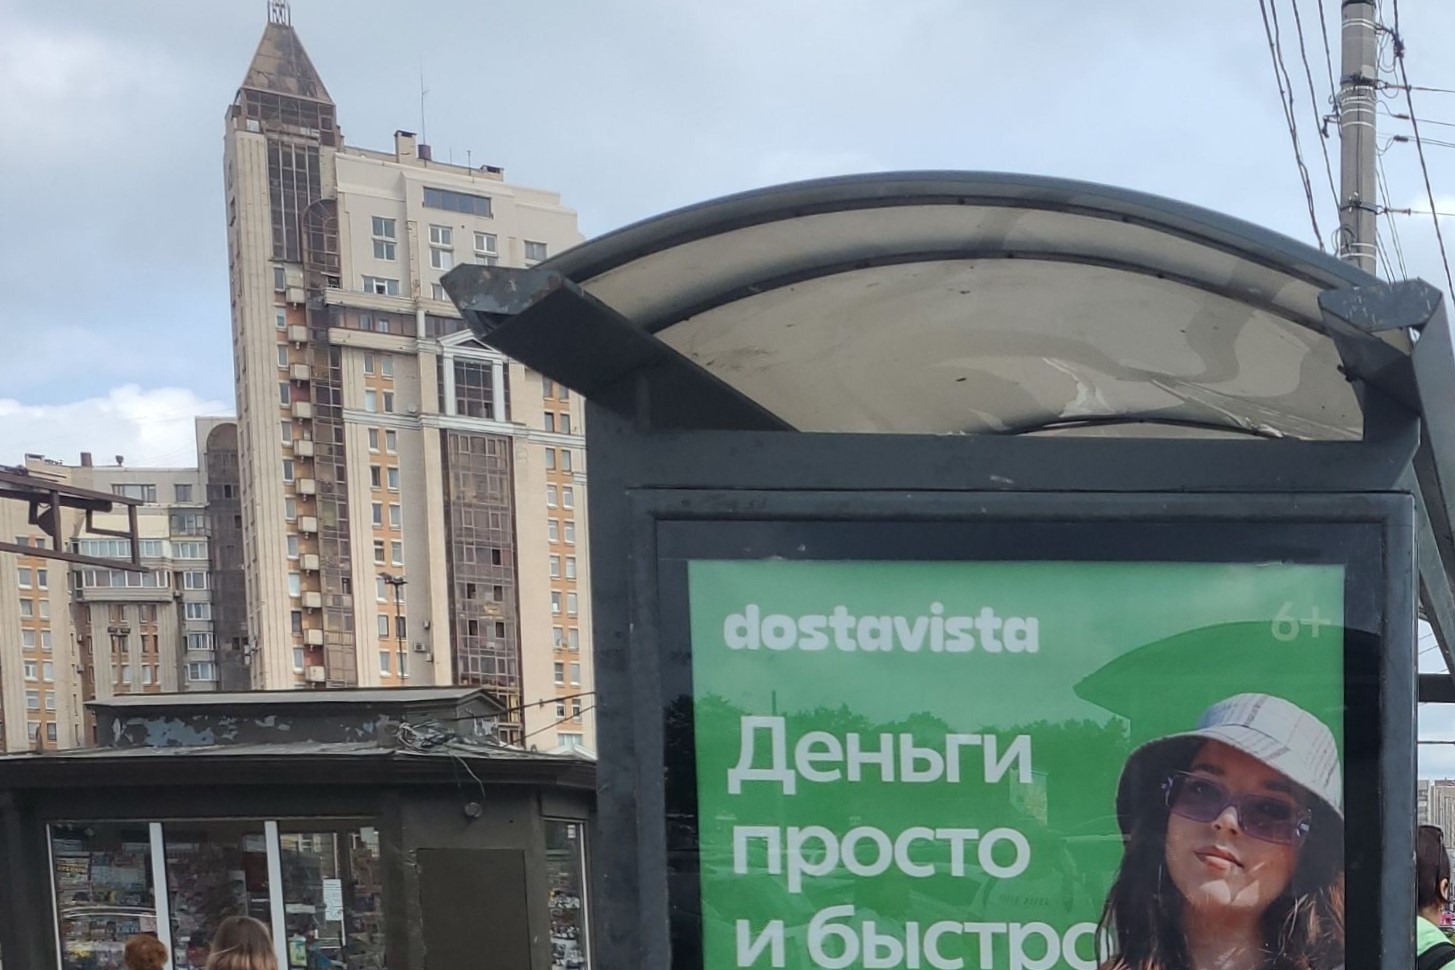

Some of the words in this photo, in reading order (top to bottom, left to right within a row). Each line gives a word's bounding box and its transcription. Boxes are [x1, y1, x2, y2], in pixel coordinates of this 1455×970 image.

[723, 602, 1040, 654] dostavista
[1271, 601, 1332, 641] 6+
[727, 715, 1033, 795] Деньги
[733, 824, 1031, 893] просто
[736, 919, 785, 968] и
